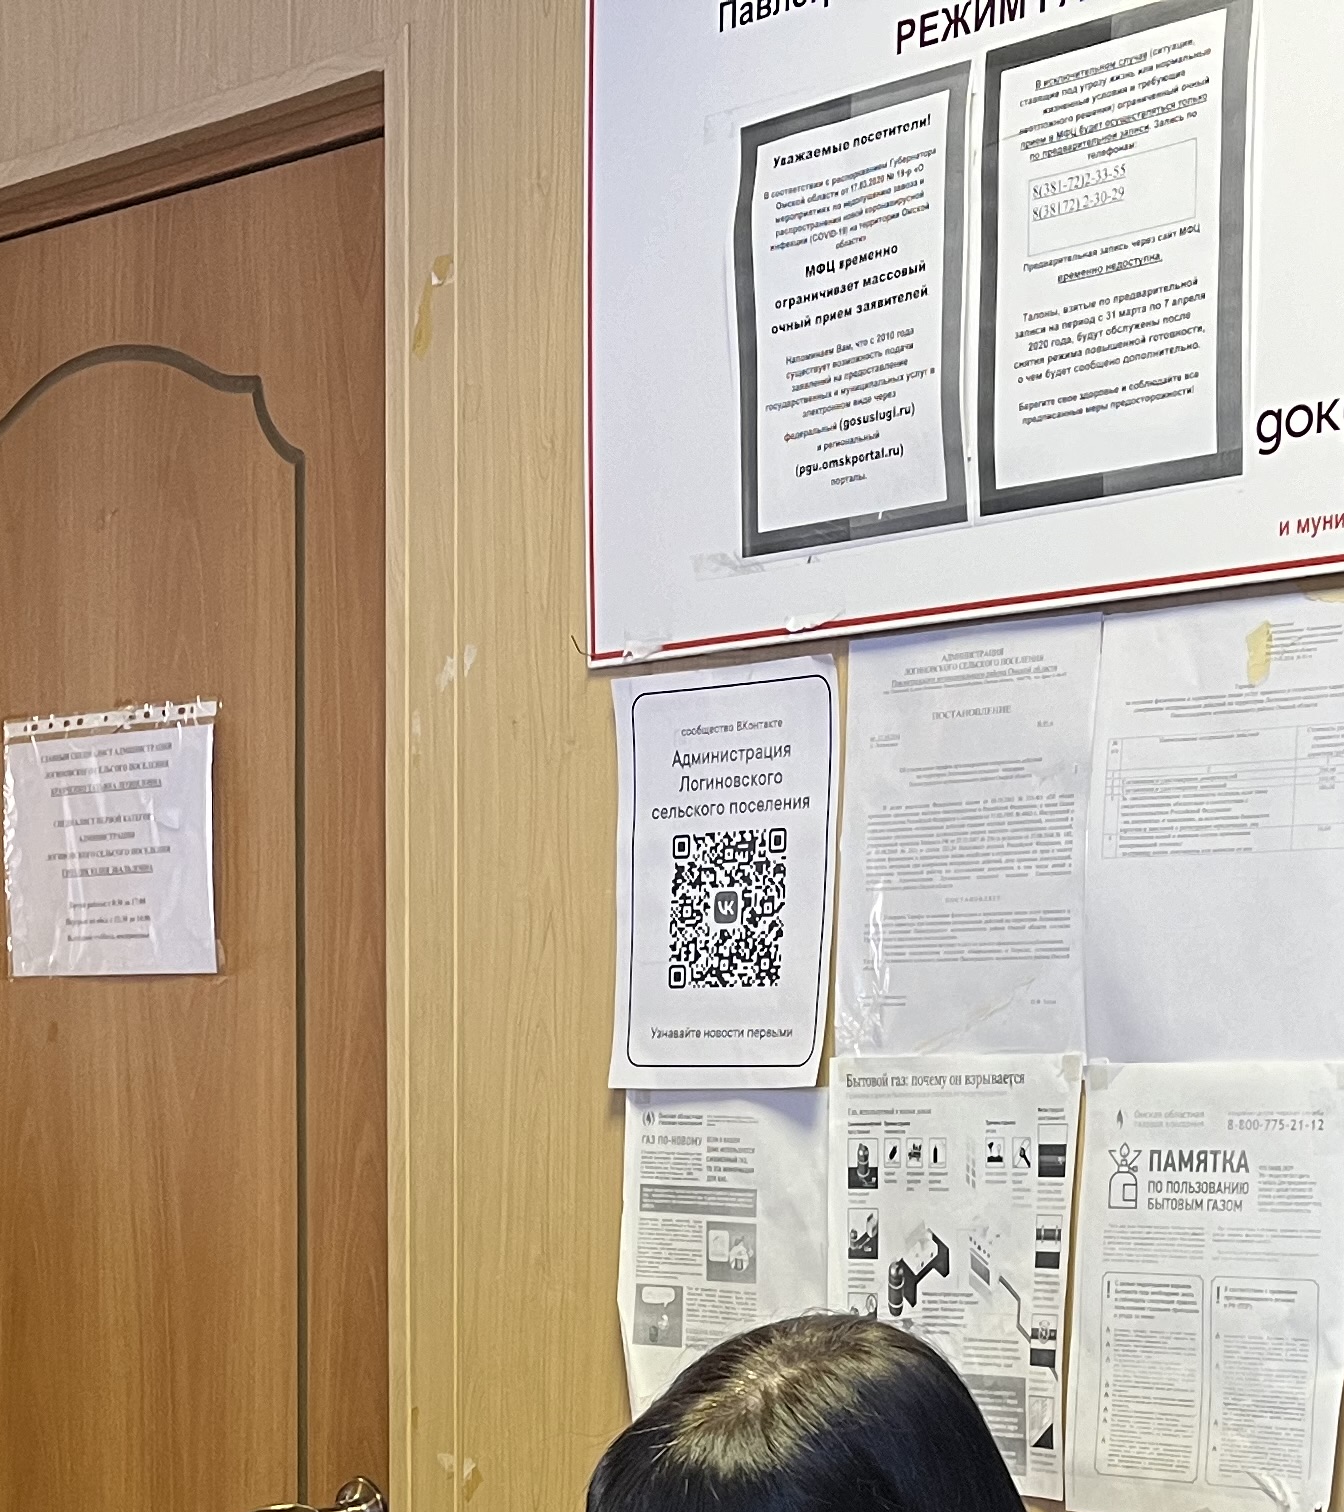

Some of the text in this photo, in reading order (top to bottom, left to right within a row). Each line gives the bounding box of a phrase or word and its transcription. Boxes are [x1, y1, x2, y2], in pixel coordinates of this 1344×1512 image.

[897, 0, 1025, 55] РЕЖИМ
[773, 141, 849, 168] Уважаемые
[805, 245, 898, 278] МФЦ временно
[862, 260, 926, 287] массовый
[771, 285, 928, 334] очный прием заявителей
[795, 444, 904, 477] (pgu.omskportal.ru)
[1279, 519, 1289, 536] и
[681, 719, 782, 737] сообщество ВКонтакте
[672, 744, 791, 769] Администрация
[679, 771, 783, 792] Логиновского
[651, 796, 810, 820] сельского поселения
[651, 1026, 792, 1040] Узнавайте новости первыми
[846, 1073, 1025, 1092] Бытовой газ: почему он взрывается
[1227, 1119, 1324, 1130] 8-800-775-21-12
[642, 1135, 702, 1146] ГАЗ ПО-НОВОМУ
[1149, 1150, 1249, 1173] ПАМЯТКА
[1148, 1181, 1249, 1194] ПО ПОЛЬЗОВАНИЮ
[1148, 1198, 1243, 1212] БЫТОВЫМ ГАЗОМ
